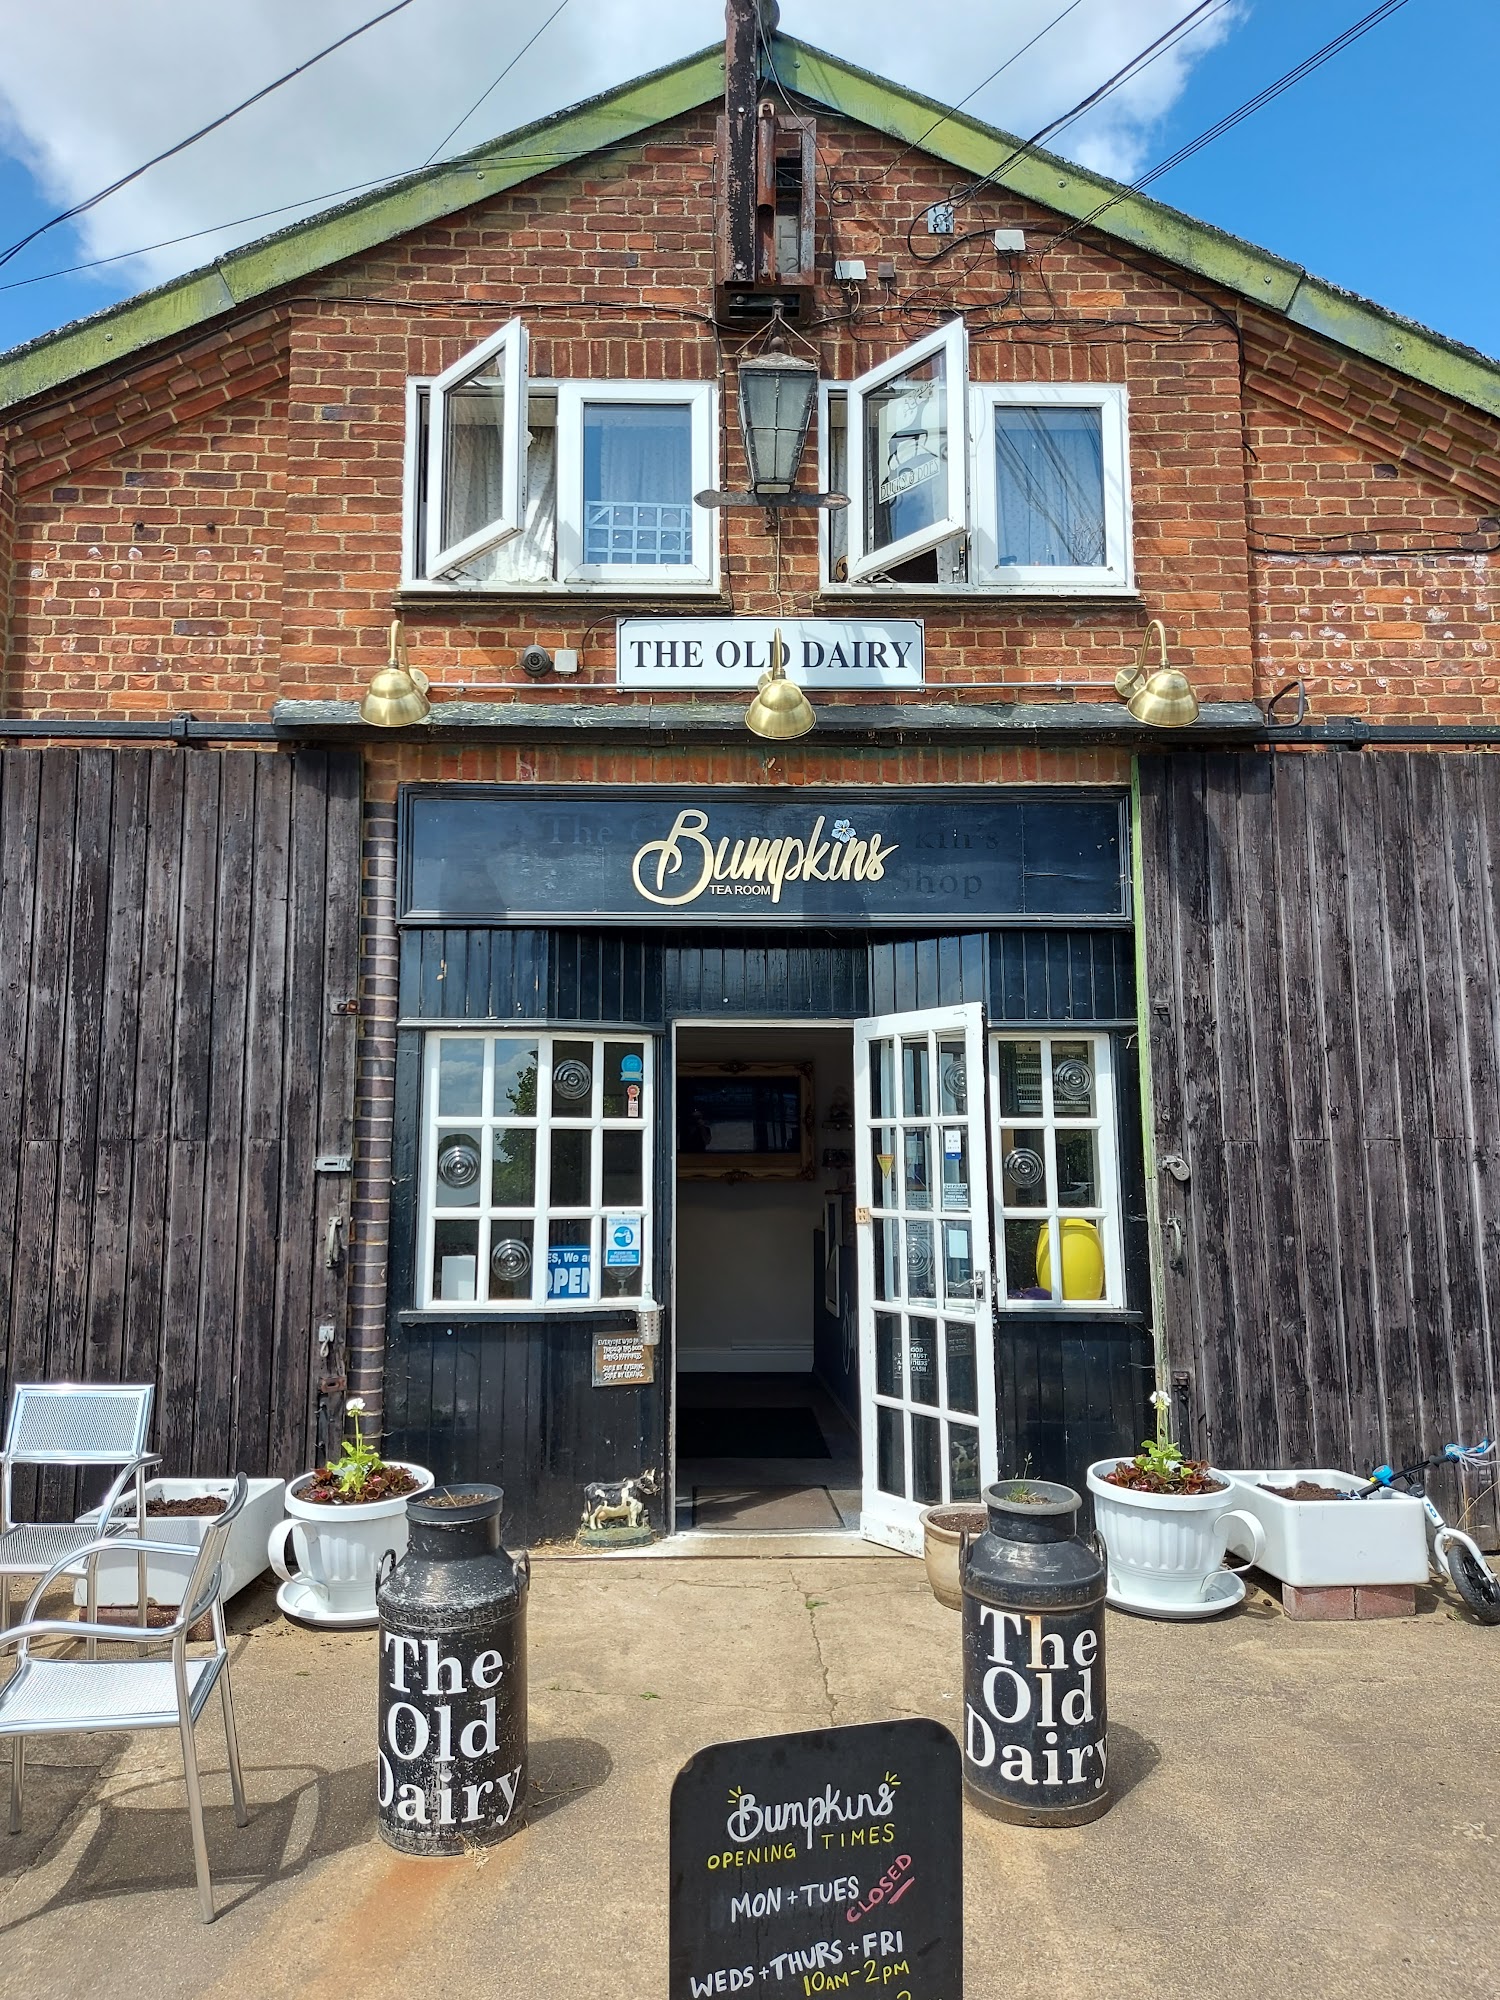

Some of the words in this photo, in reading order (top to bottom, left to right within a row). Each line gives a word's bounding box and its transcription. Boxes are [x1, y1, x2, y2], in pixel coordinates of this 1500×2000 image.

[630, 640, 704, 668] THE
[716, 640, 791, 669] OLD
[801, 641, 914, 669] DAIRY
[632, 809, 900, 907] Bumpkins
[709, 885, 733, 896] TEA
[734, 885, 771, 896] ROOM
[564, 1252, 579, 1262] We
[384, 1631, 504, 1695] The
[980, 1605, 1098, 1669] The
[982, 1666, 1094, 1727] Old
[387, 1697, 500, 1762] Old
[966, 1702, 1109, 1789] Dairy
[378, 1745, 522, 1826] Dairy
[727, 1783, 896, 1849] Bumpkins
[707, 1843, 797, 1870] OPENING
[821, 1823, 895, 1850] TIMES
[731, 1887, 781, 1923] MON
[799, 1875, 860, 1907] TUES
[846, 1854, 912, 1923] CLOSED
[690, 1966, 754, 1999] WEDS
[769, 1939, 844, 1981] THURS
[862, 1930, 903, 1958] FRI
